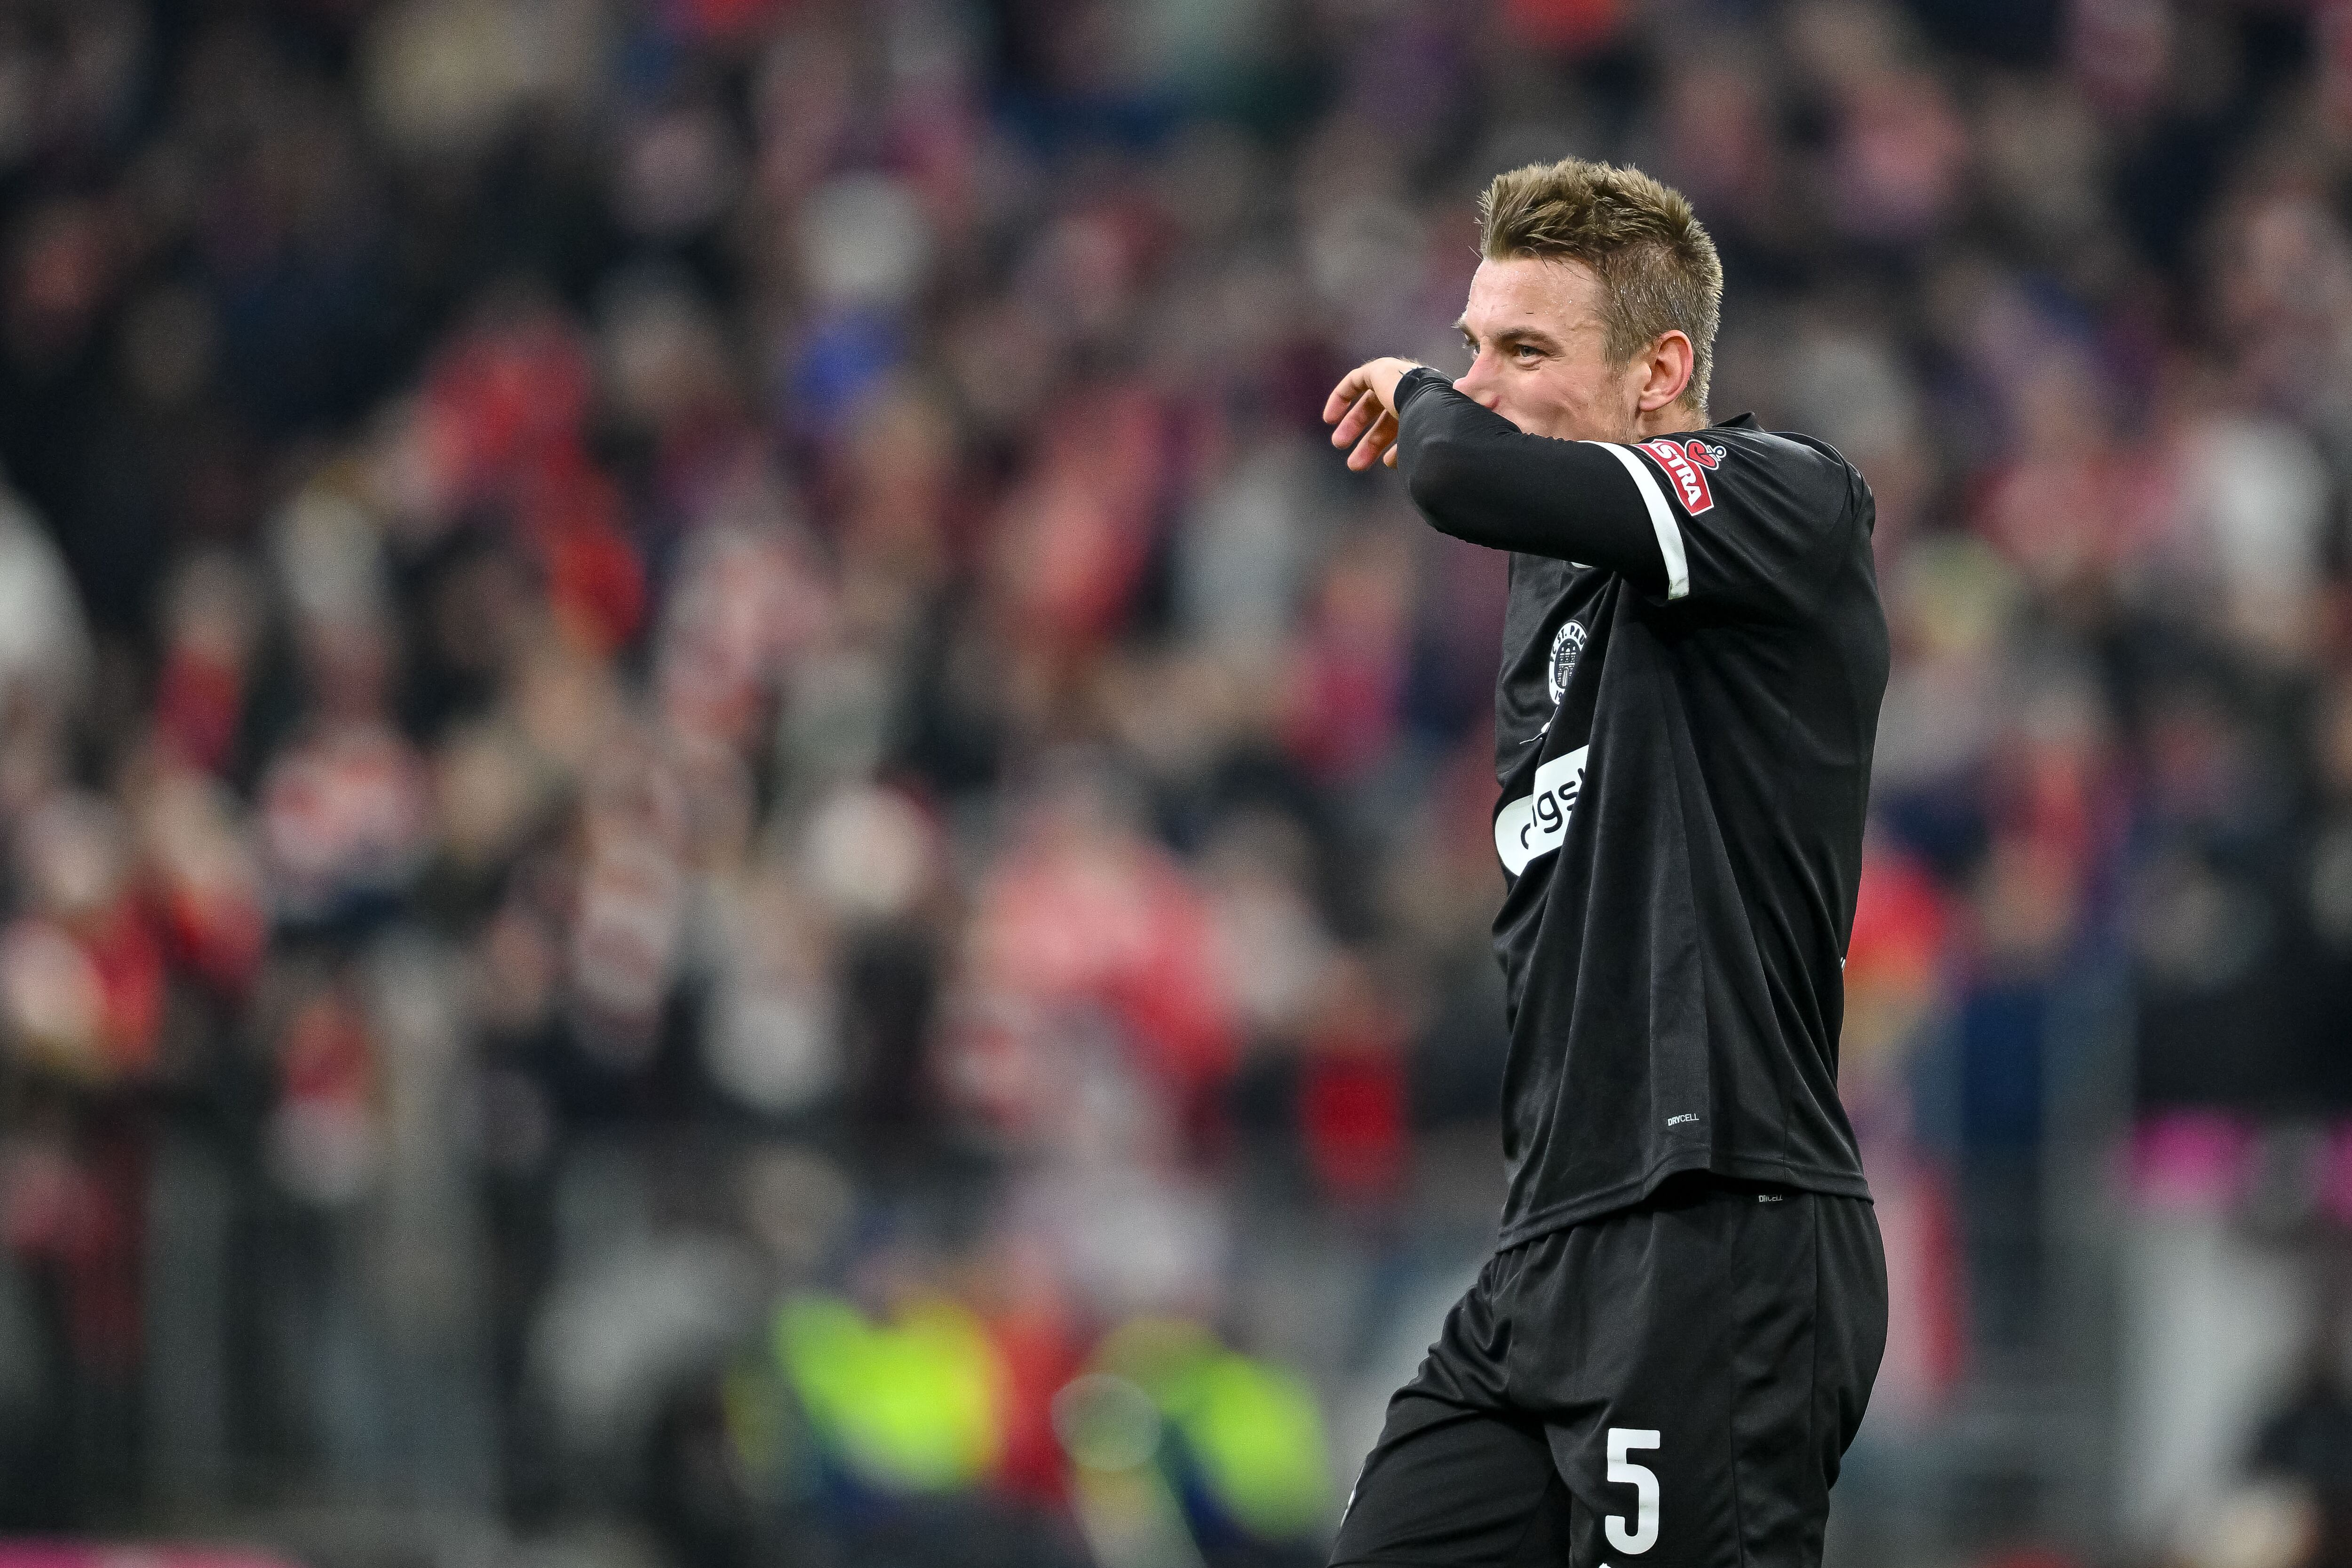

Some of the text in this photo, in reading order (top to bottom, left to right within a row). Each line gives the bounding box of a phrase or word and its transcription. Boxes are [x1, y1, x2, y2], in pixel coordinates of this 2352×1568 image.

[1648, 442, 1702, 507] STRA
[1557, 628, 1567, 644] ST.
[1570, 625, 1585, 645] PAU
[1668, 1113, 1700, 1126] DRYCELL
[1605, 1428, 1660, 1554] 5
